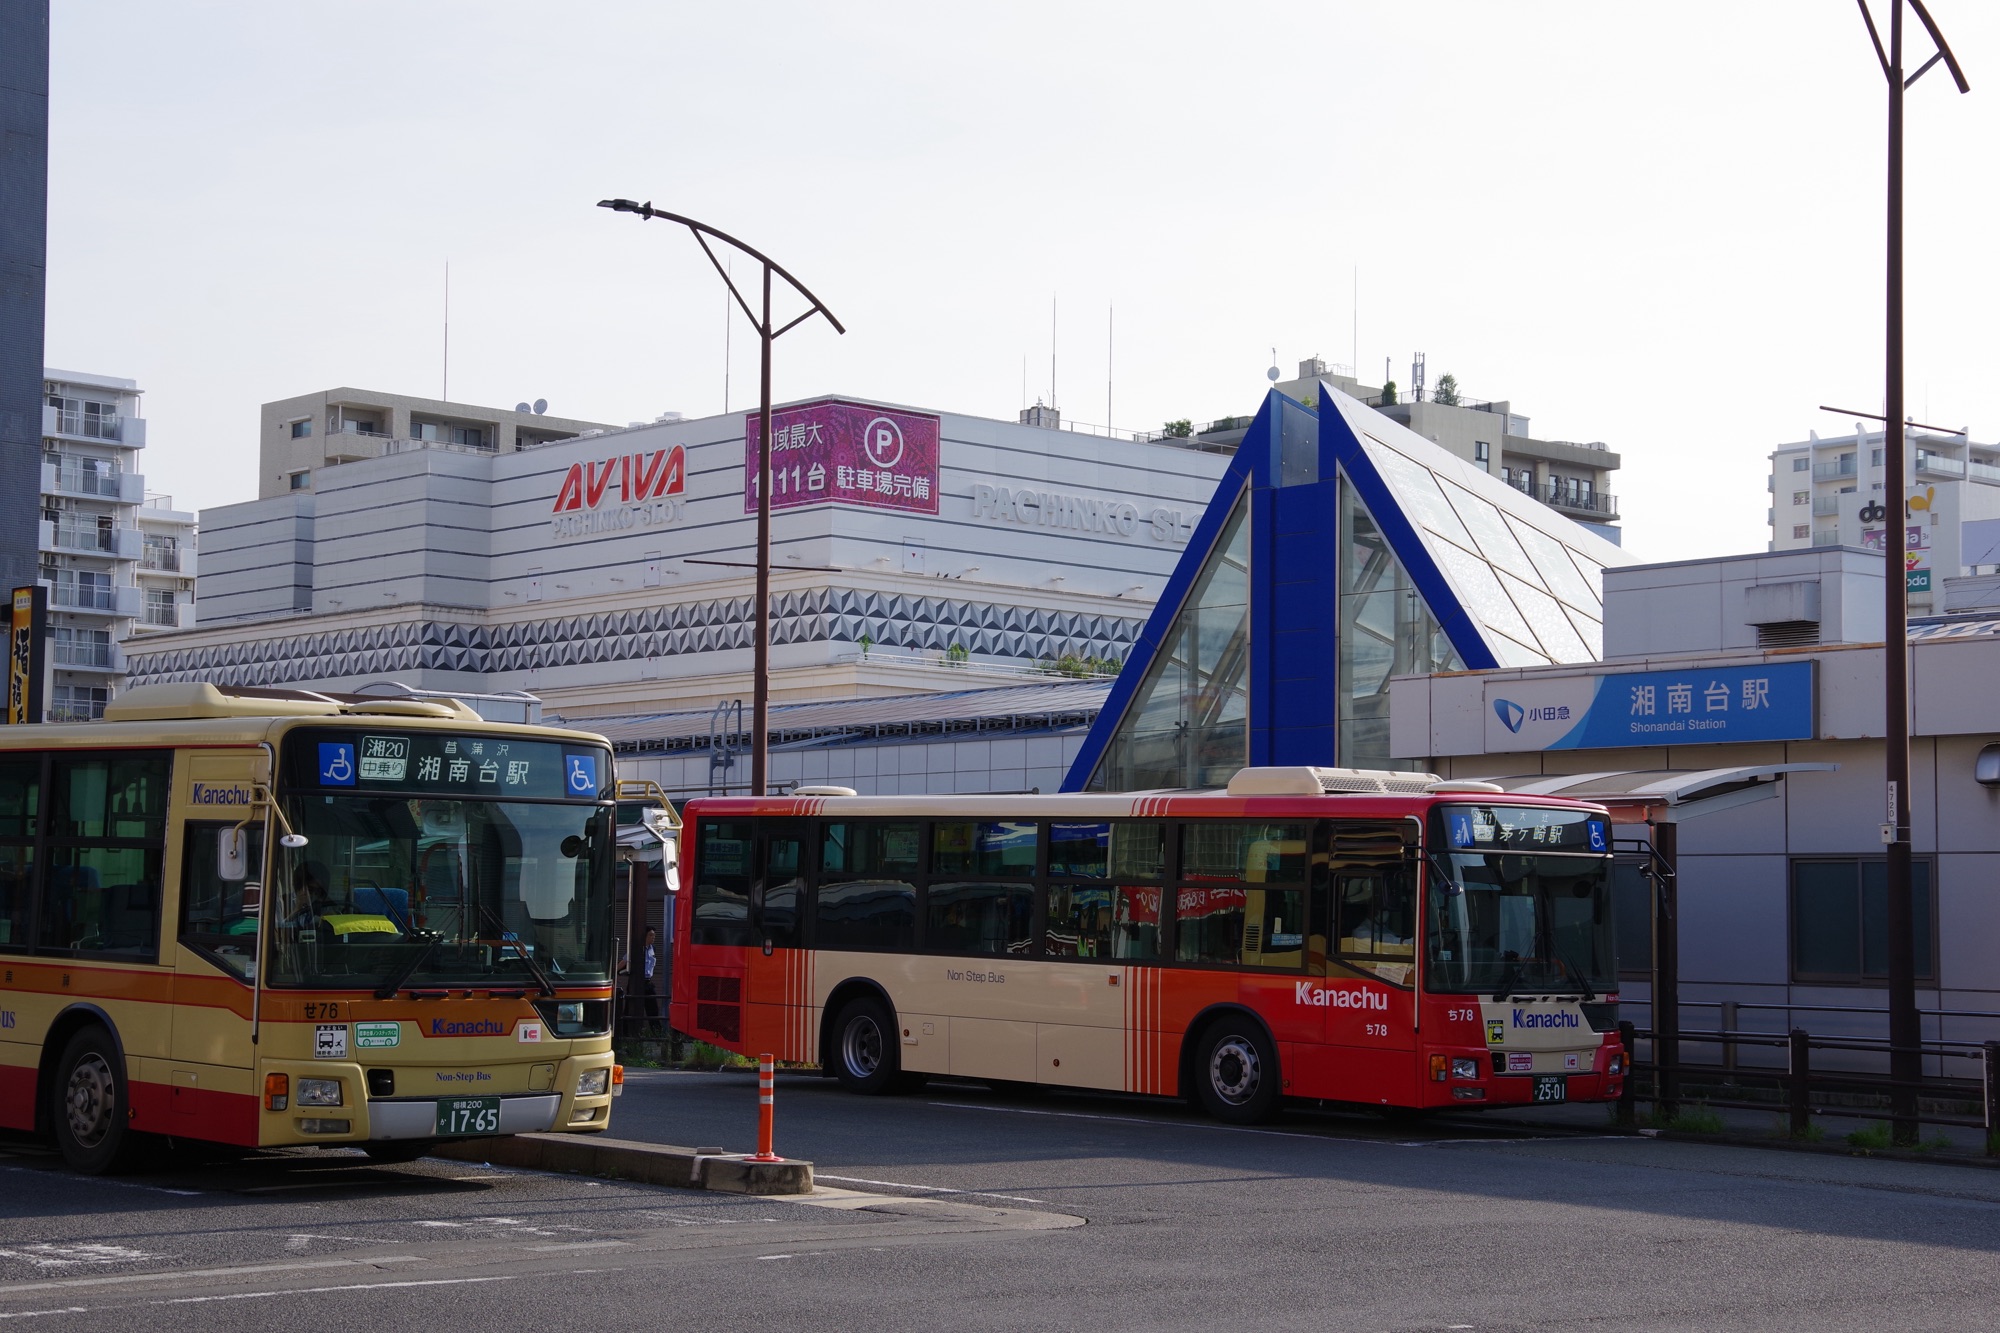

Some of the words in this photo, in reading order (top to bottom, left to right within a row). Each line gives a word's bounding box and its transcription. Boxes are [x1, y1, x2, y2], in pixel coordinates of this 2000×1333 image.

[552, 444, 686, 514] AVIVA
[837, 465, 930, 499] 駐車場完備
[552, 505, 634, 539] PACHINKO
[641, 497, 687, 525] SLOT
[974, 484, 1139, 536] PACHINKO
[1152, 508, 1202, 543] SL
[1630, 678, 1770, 716] 湘南台駅
[1528, 706, 1571, 721] 小田急
[1630, 721, 1685, 733] Shonandai
[1688, 718, 1726, 731] Station
[366, 738, 404, 758] 湘20
[445, 741, 509, 756] 菖蒲沢
[363, 761, 404, 776] 中乗り
[417, 756, 529, 785] 湘南台駅
[193, 783, 249, 804] Kanachu
[947, 969, 964, 981] Non
[966, 970, 986, 983] Step
[988, 972, 1005, 983] Bus
[1295, 981, 1388, 1010] Kanachu
[0, 1007, 15, 1028] us
[304, 1002, 338, 1019] せ76
[1448, 1009, 1474, 1021] ち78
[1513, 1008, 1579, 1028] Kanachu
[432, 1018, 504, 1035] Kanachu
[1366, 1024, 1388, 1036] ち78
[436, 1072, 474, 1082] Non-Step
[476, 1071, 491, 1081] Bus
[453, 1100, 482, 1109] 相模200
[450, 1109, 497, 1132] 17-65
